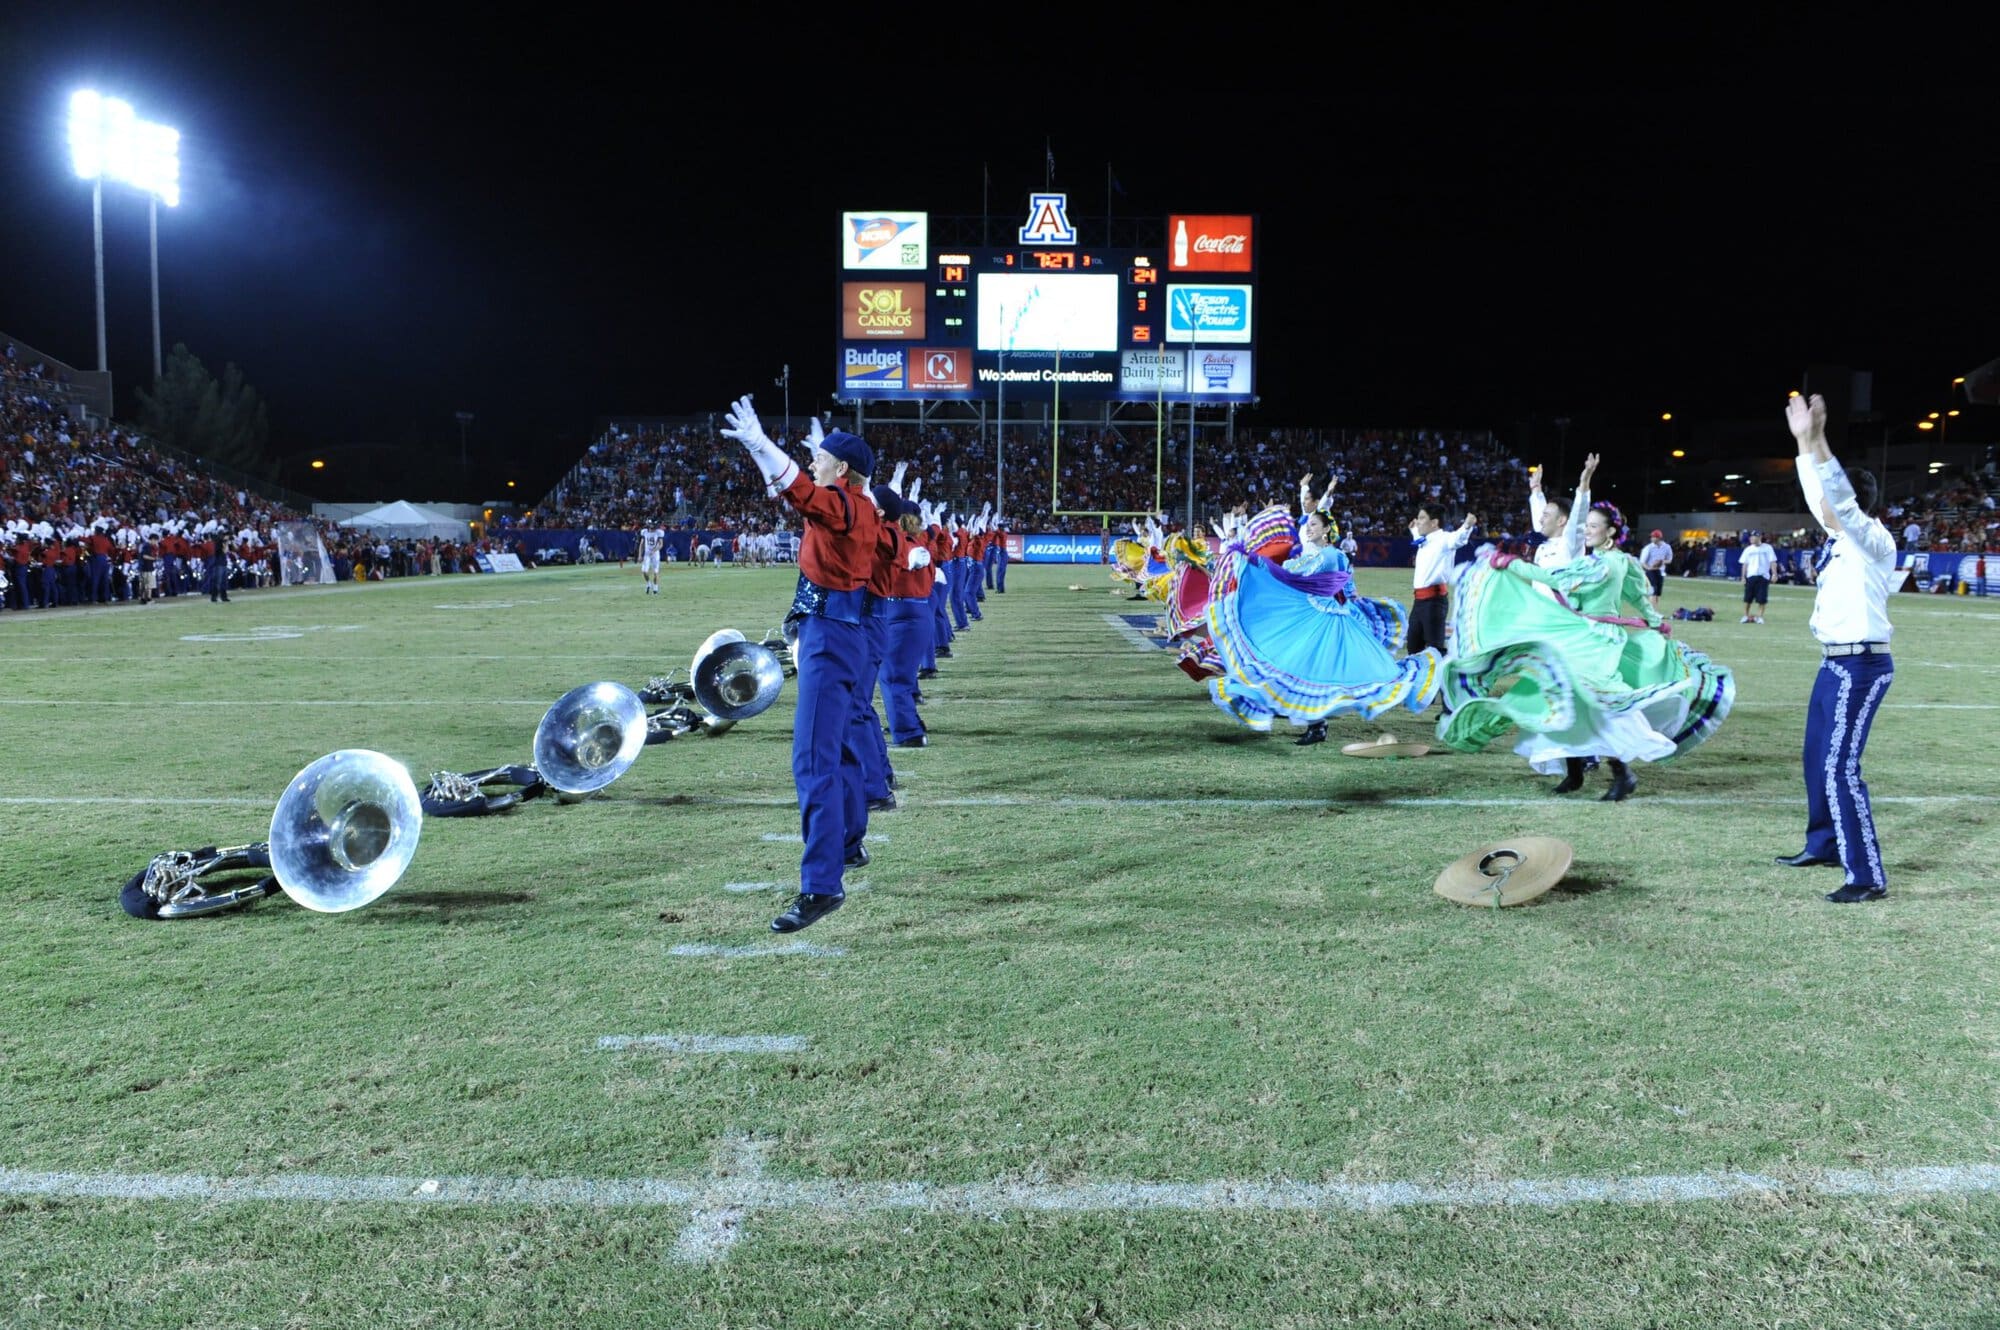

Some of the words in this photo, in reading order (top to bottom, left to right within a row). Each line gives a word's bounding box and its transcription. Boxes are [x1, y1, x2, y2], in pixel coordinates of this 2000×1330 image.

[1019, 193, 1076, 244] A
[1193, 234, 1247, 254] Coca-Cola
[1033, 252, 1074, 268] 7:27
[1134, 269, 1156, 283] 24
[858, 289, 911, 315] SOL
[1190, 293, 1230, 304] Tucson
[1194, 304, 1240, 315] Electric
[858, 315, 912, 327] CASINOS
[1199, 314, 1240, 326] Power
[845, 349, 903, 370] Budget
[978, 369, 1040, 381] Woodward
[1043, 369, 1113, 382] Construction
[1121, 366, 1154, 380] Daily
[1157, 366, 1183, 378] Star
